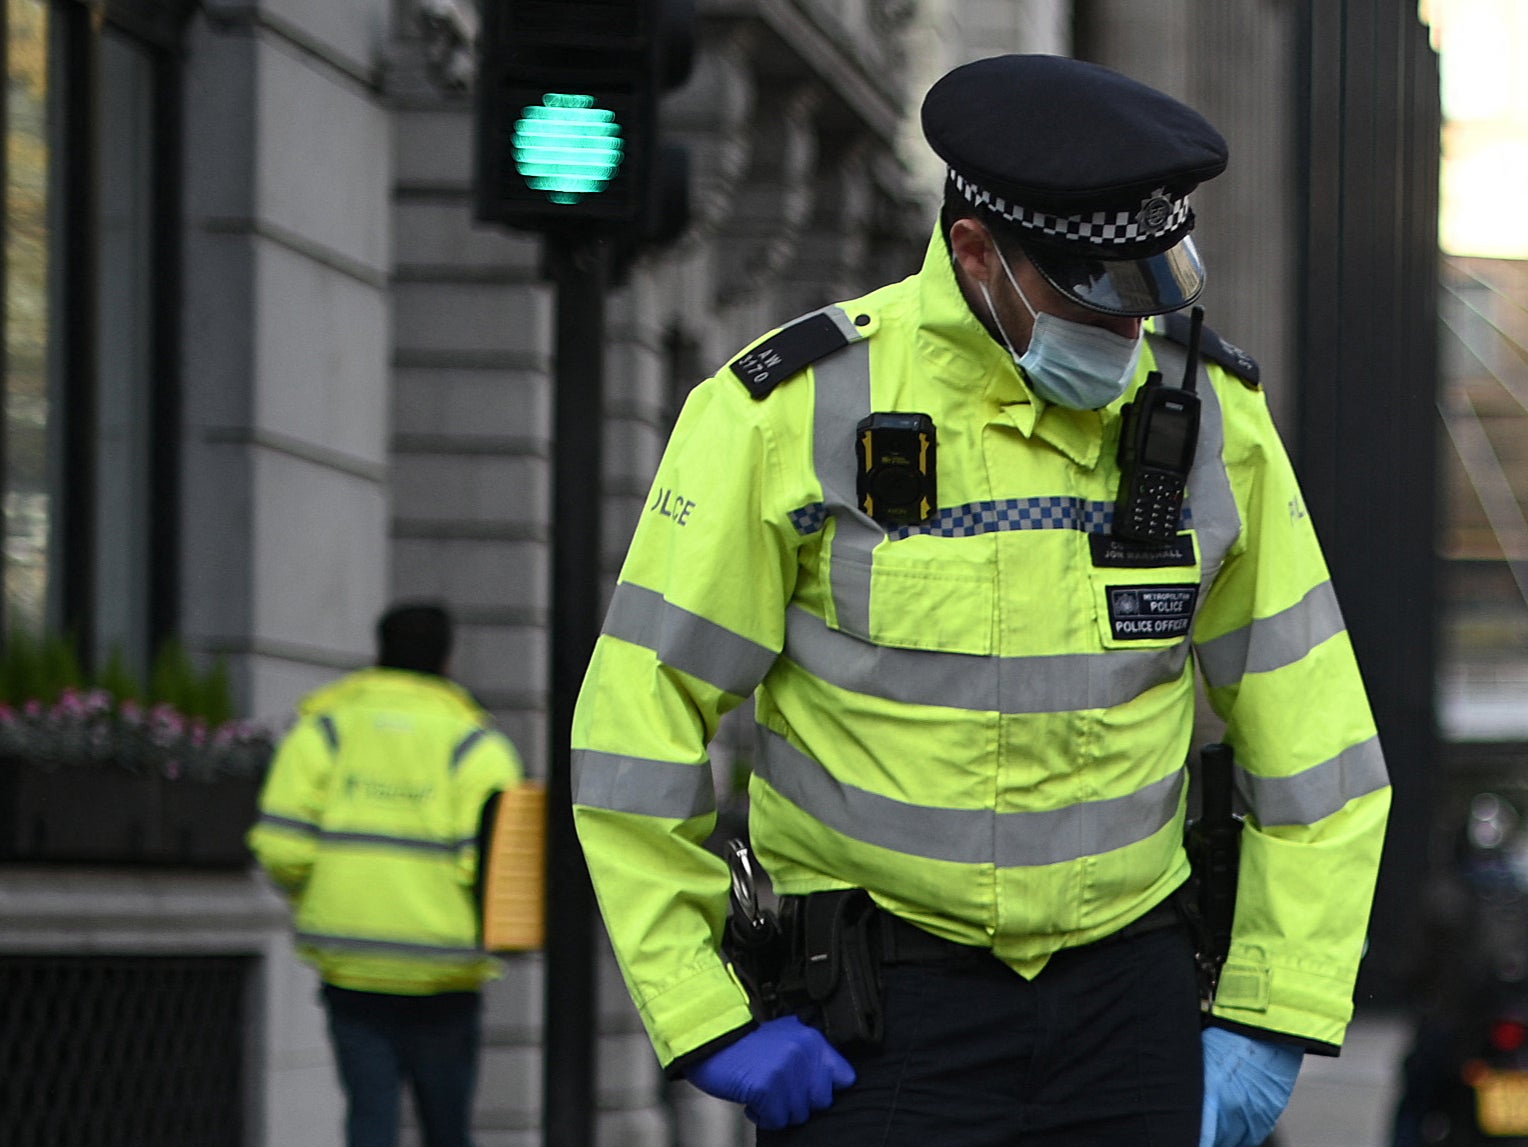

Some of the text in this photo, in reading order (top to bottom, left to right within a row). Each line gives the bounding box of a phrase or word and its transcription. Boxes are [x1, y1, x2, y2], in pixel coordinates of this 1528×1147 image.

[758, 349, 783, 368] AW
[1150, 601, 1184, 612] POLICE
[1115, 618, 1188, 633] POLICE OFFICER
